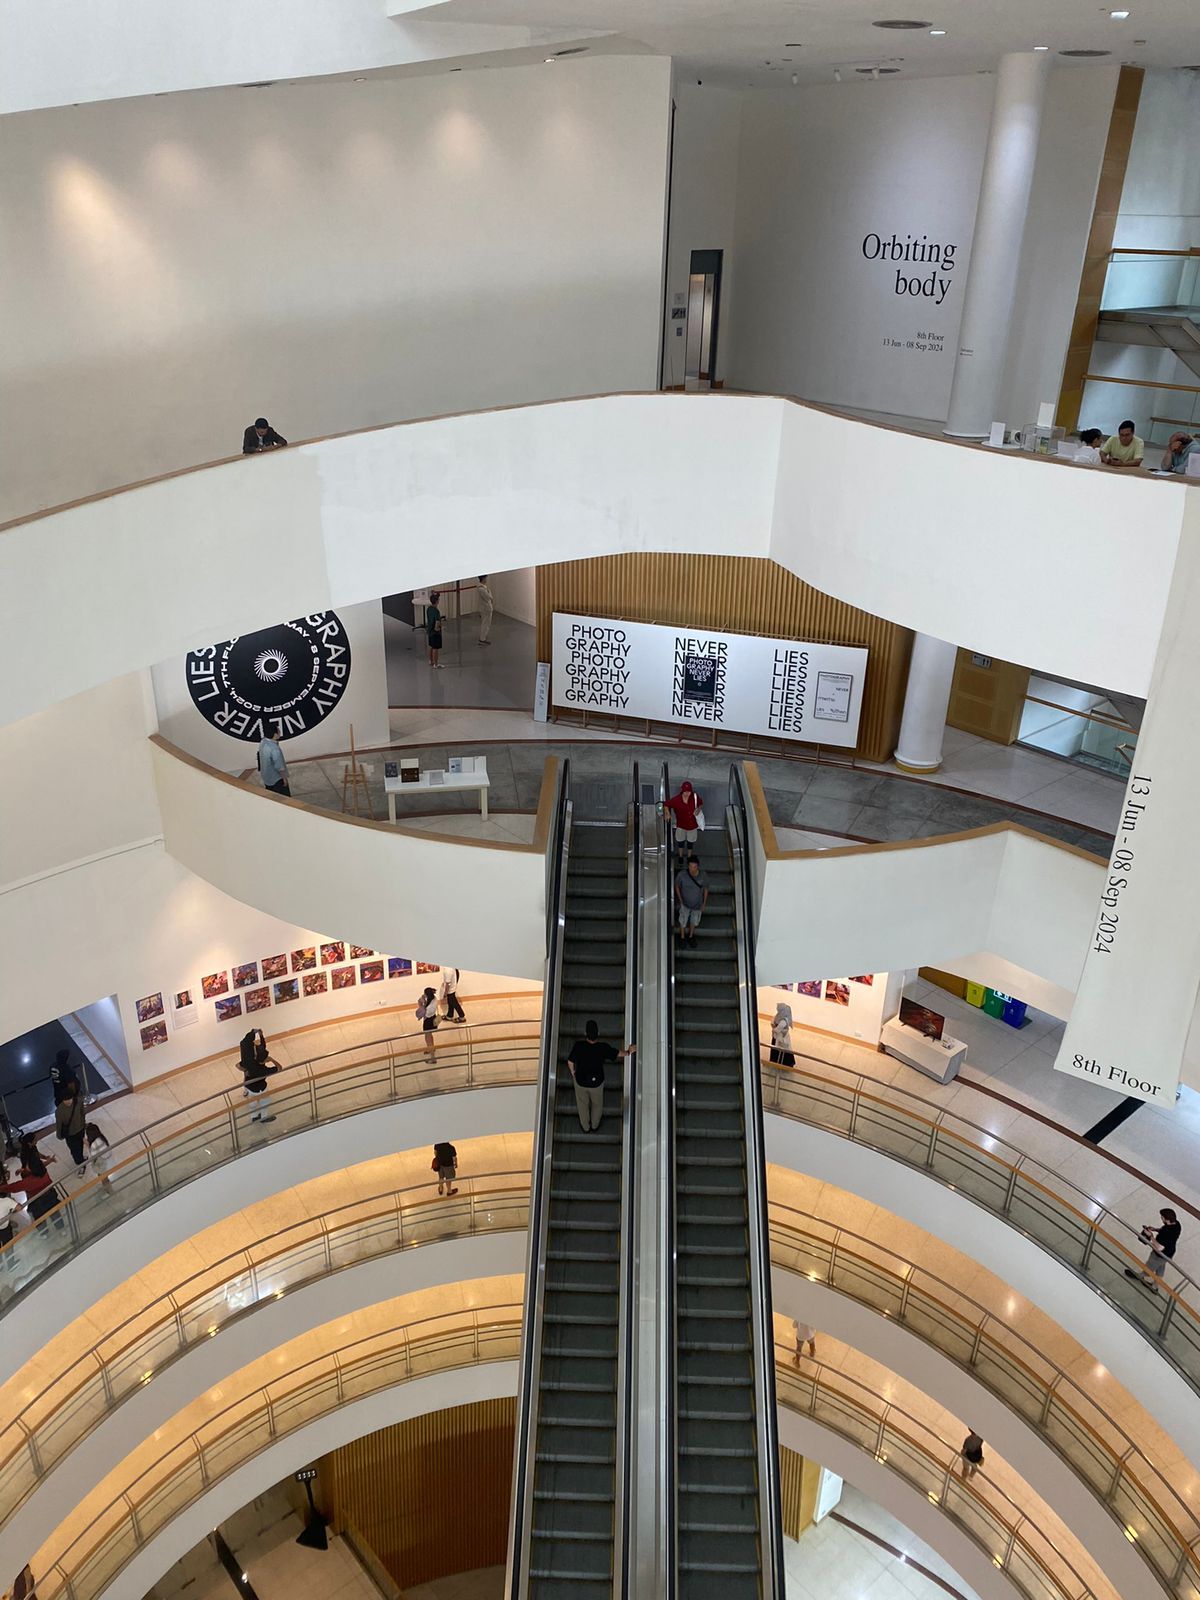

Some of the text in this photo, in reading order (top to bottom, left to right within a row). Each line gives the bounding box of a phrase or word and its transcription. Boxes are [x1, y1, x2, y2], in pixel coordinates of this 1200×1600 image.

[862, 233, 957, 271] Orbiting
[895, 269, 952, 305] body
[882, 338, 890, 346] 13
[891, 339, 902, 348] Jun
[906, 340, 914, 349] 08
[915, 342, 927, 352] Sep
[928, 343, 943, 352] 2024
[916, 332, 945, 342] 8th Floor
[572, 624, 626, 643] PHOTO
[566, 637, 631, 657] GRAPHY
[675, 637, 728, 656] NEVER
[571, 651, 625, 669] PHOTO
[686, 662, 715, 672] GRAPHY
[689, 657, 713, 666] PHOTO
[774, 649, 809, 666] LIES
[191, 646, 219, 701] LIES
[220, 661, 231, 688] 7TH
[565, 664, 630, 683] GRAPHY
[773, 663, 808, 679] LIES
[263, 656, 320, 712] SEPTEMBER
[571, 677, 624, 695] PHOTO
[772, 676, 806, 693] LIES
[565, 689, 629, 708] GRAPHY
[770, 690, 805, 706] LIES
[672, 703, 724, 722] NEVER
[769, 703, 803, 719] LIES
[768, 717, 802, 733] LIES
[1131, 775, 1152, 796] 13
[1122, 800, 1145, 832] Jun
[1112, 849, 1134, 872] 08
[1101, 876, 1128, 908] Sep
[1094, 912, 1119, 954] 2024
[1072, 1054, 1161, 1095] 8th Floor
